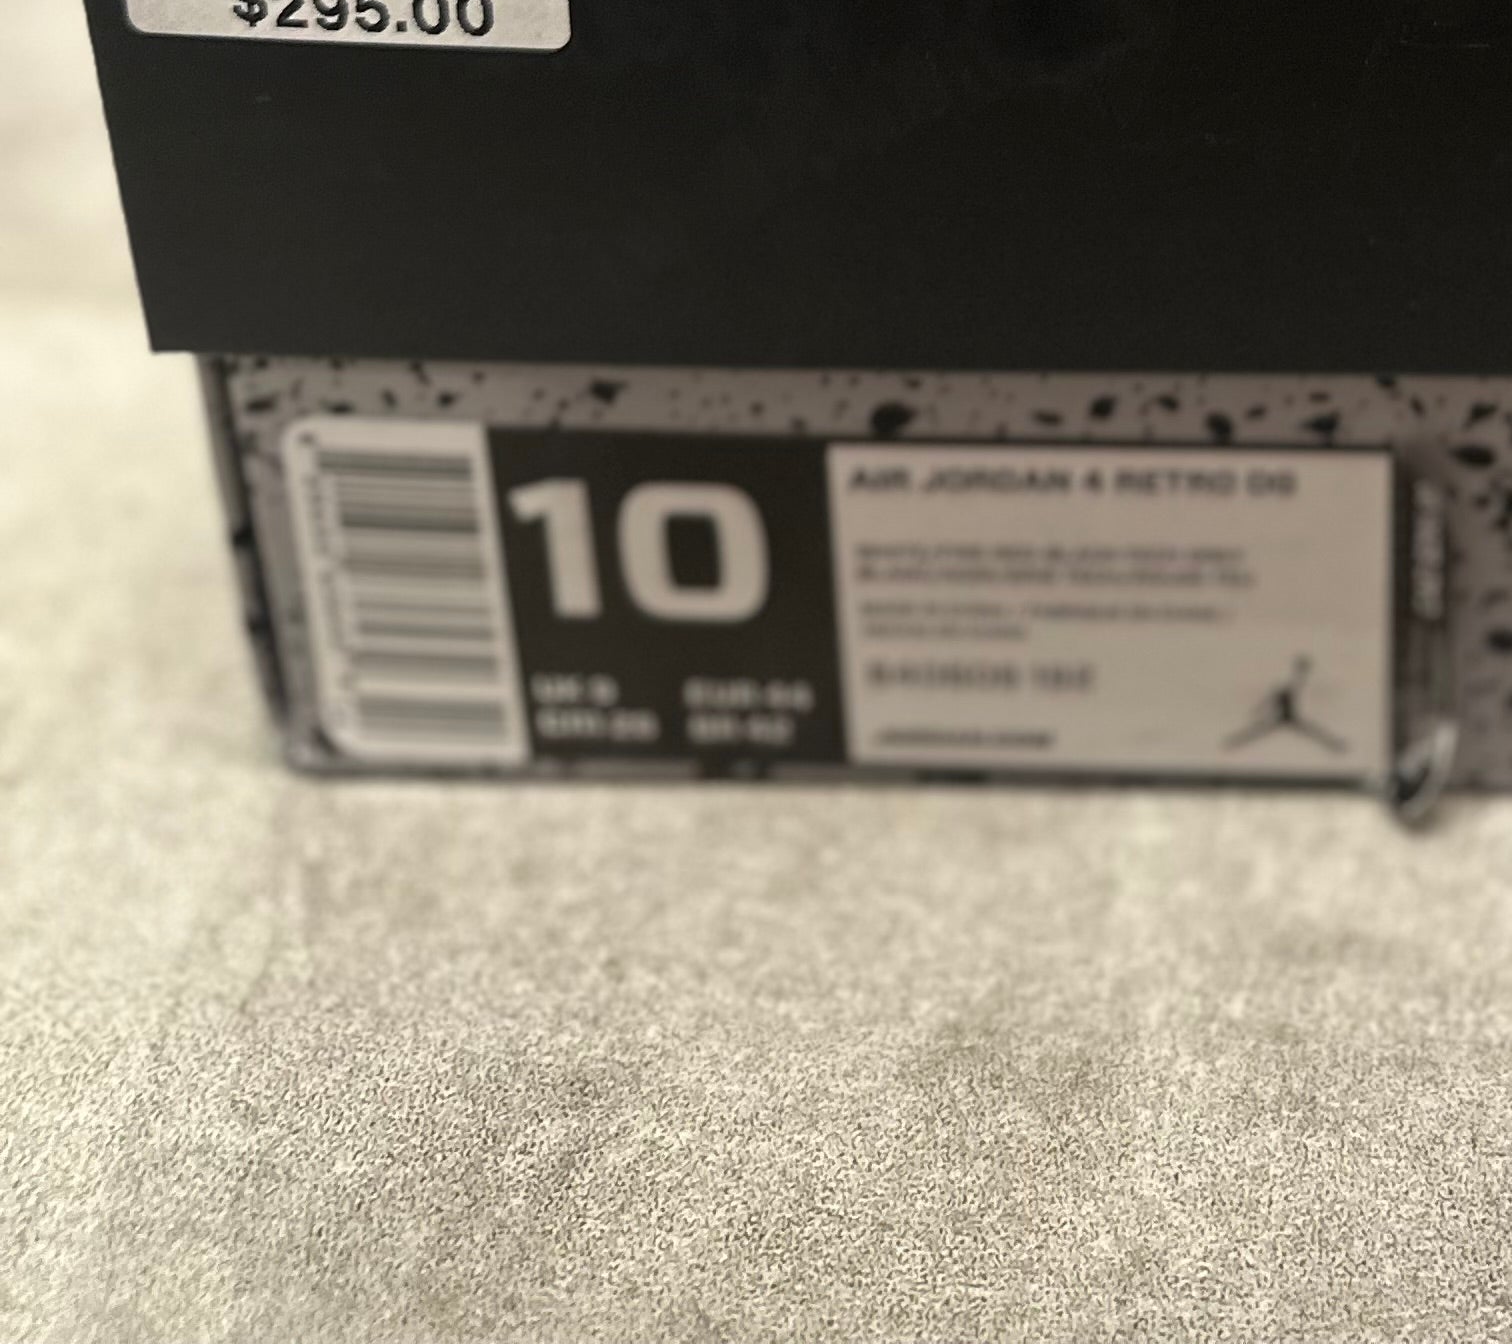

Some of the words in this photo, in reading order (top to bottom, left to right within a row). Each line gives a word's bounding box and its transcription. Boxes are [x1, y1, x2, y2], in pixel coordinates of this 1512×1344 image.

[849, 467, 911, 494] AIR
[921, 467, 1072, 495] JORDAN
[1084, 468, 1105, 495] 4
[1115, 468, 1237, 496] RETRO
[507, 477, 769, 624] 10
